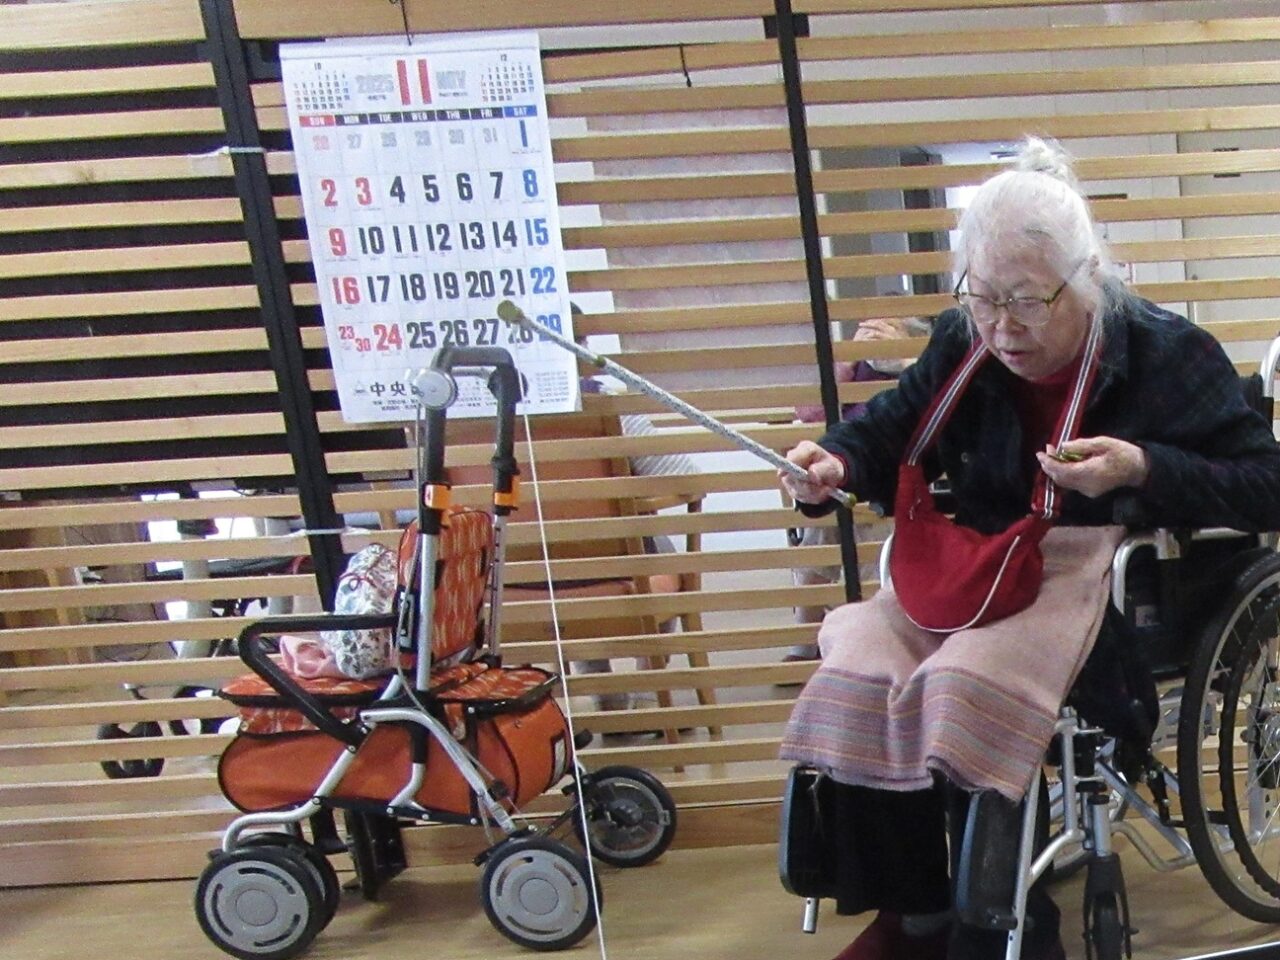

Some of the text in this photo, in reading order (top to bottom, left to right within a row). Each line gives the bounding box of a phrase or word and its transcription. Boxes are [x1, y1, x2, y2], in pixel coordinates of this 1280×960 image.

[397, 60, 431, 105] 11
[309, 116, 326, 125] SUN
[379, 113, 393, 122] TUE
[411, 112, 428, 121] WED
[480, 109, 493, 118] FRI
[513, 107, 527, 117] SAT
[347, 134, 361, 149] 27
[483, 128, 498, 144] 31
[520, 120, 527, 147] 1
[322, 169, 538, 206] 2 3 4 5 6 7 8
[329, 218, 548, 256] 9 10 11 12 13 14 15
[333, 266, 556, 304] 16 17 18 19 20 21 22
[339, 325, 355, 341] 23
[355, 337, 371, 352] 30
[374, 324, 402, 350] 24
[407, 322, 436, 348] 25
[439, 320, 470, 348] 26
[473, 318, 500, 345] 27
